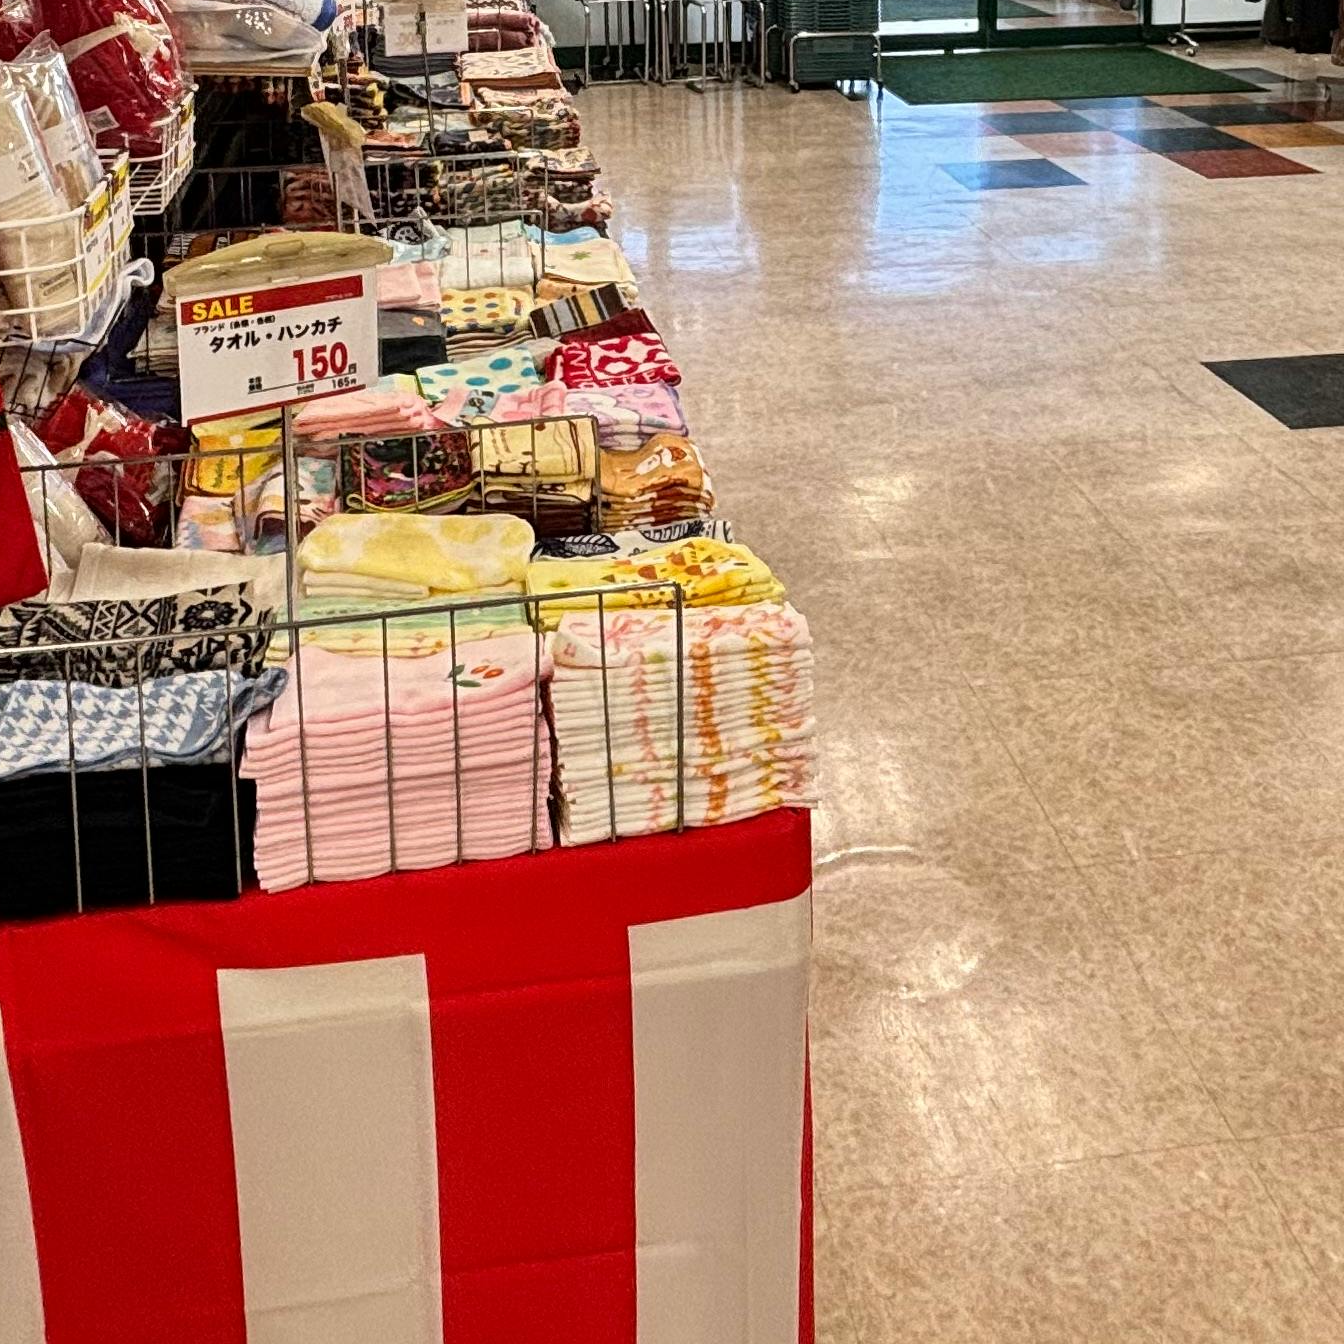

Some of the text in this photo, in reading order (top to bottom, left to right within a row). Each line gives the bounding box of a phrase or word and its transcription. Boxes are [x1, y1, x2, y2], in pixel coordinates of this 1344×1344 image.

[192, 295, 254, 321] SALE
[209, 316, 343, 354] タオル・ハンカチ
